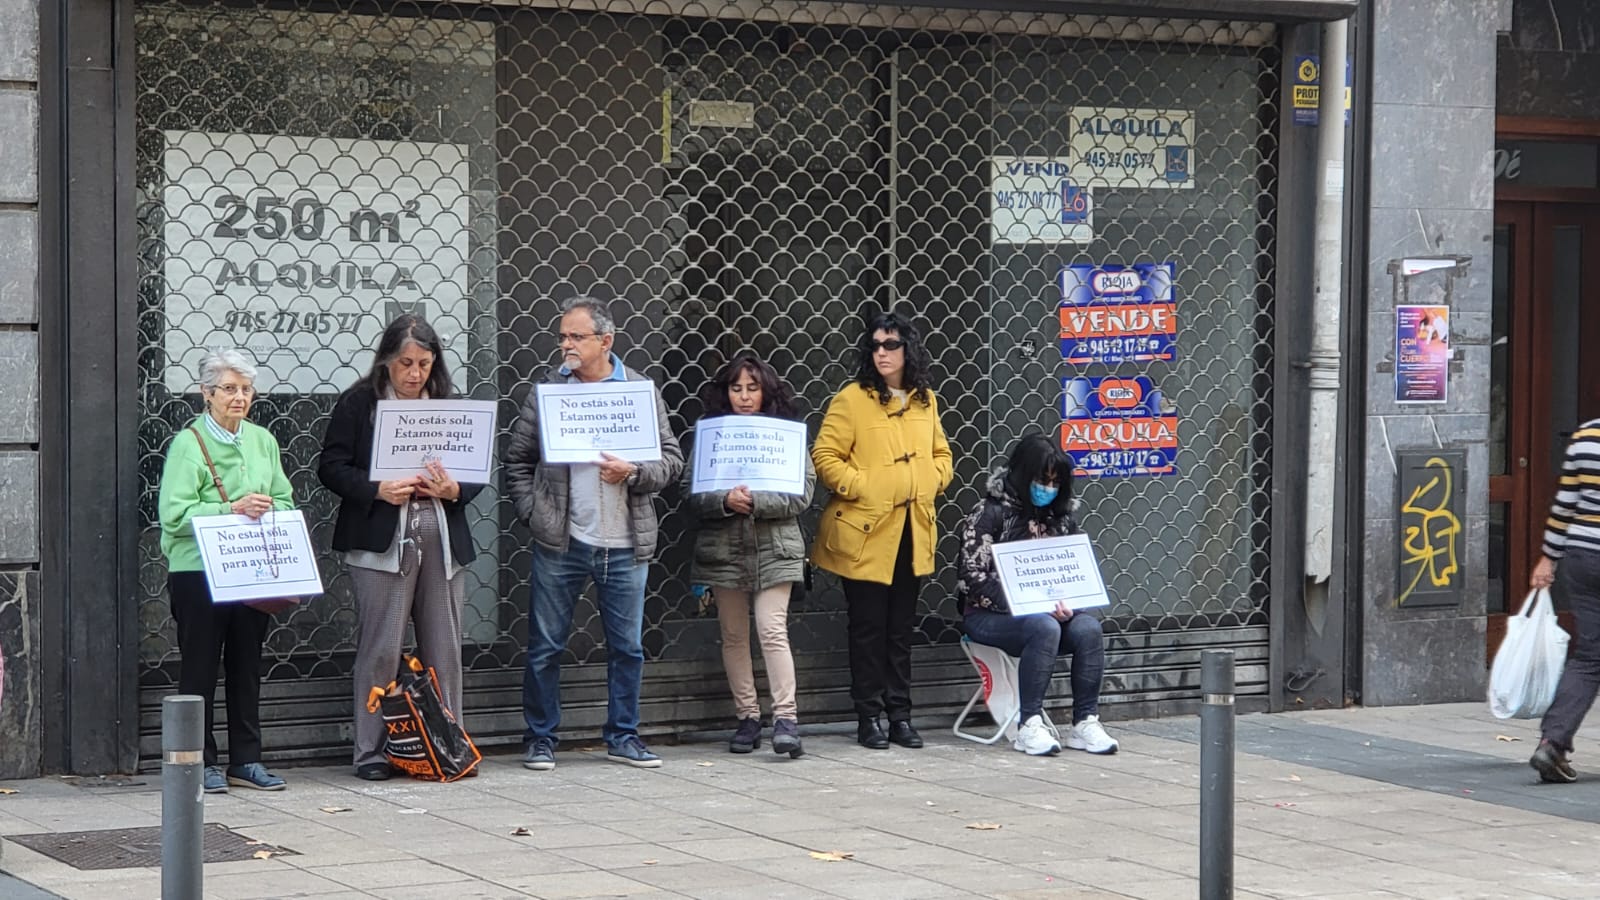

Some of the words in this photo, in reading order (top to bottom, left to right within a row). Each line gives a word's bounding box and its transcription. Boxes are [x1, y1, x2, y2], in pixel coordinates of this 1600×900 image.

[1081, 118, 1183, 137] ALQUILA
[1063, 188, 1085, 212] L6
[213, 195, 326, 241] 250
[215, 262, 418, 291] ALQUILA
[1102, 276, 1133, 288] RIOJA
[225, 311, 266, 333] 945
[273, 312, 297, 333] 27
[337, 313, 363, 333] 77
[1069, 308, 1167, 333] VENDE
[1090, 340, 1109, 354] 945
[1125, 338, 1136, 352] 17
[560, 398, 578, 409] No
[581, 397, 609, 408] estás
[611, 396, 634, 407] sola
[398, 415, 416, 426] No
[418, 415, 446, 425] estás
[450, 415, 473, 425] sola
[560, 411, 608, 421] Estamos
[610, 409, 636, 422] aquí
[395, 428, 443, 438] Estamos
[446, 429, 473, 441] aquí
[560, 427, 585, 437] para
[588, 423, 640, 436] ayudarte
[714, 431, 731, 440] No
[734, 430, 760, 439] estás
[762, 432, 784, 442] sola
[1066, 422, 1173, 448] ALQUILA
[391, 444, 417, 455] para
[420, 441, 475, 454] ayudarte
[712, 442, 758, 452] Estamos
[760, 444, 785, 454] aquí
[710, 458, 734, 468] para
[736, 454, 788, 466] ayudarte
[1090, 452, 1108, 466] 945
[1123, 451, 1133, 465] 17
[1136, 451, 1148, 465] 17
[217, 530, 236, 542] No
[266, 526, 289, 538] sola
[219, 544, 267, 556] Estamos
[269, 540, 293, 553] aquí
[222, 560, 248, 572] para
[250, 554, 299, 569] ayudarte
[1013, 555, 1030, 565] No
[1031, 553, 1054, 563] estás
[1056, 550, 1076, 559] sola
[1015, 567, 1057, 577] Estamos
[1059, 562, 1080, 574] aquí
[1018, 581, 1040, 592] para
[1042, 574, 1086, 587] ayudarte
[387, 720, 417, 735] XXI
